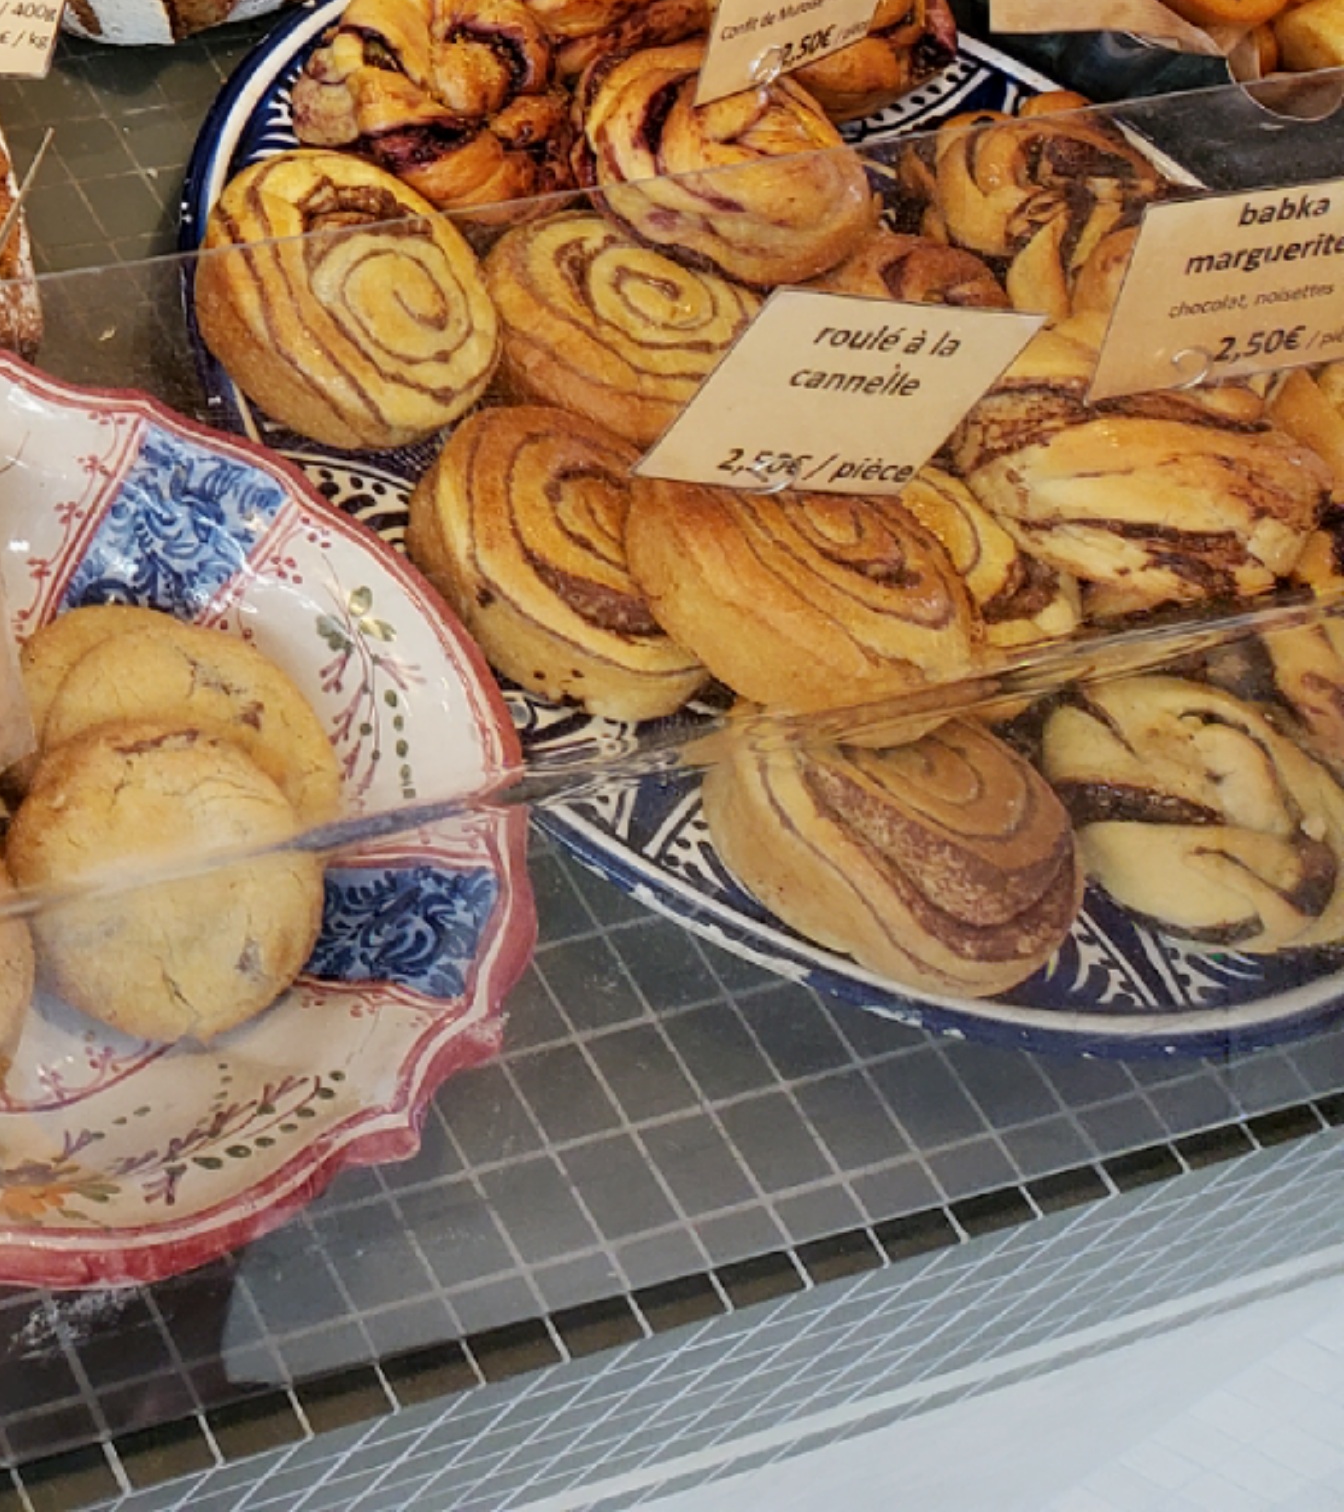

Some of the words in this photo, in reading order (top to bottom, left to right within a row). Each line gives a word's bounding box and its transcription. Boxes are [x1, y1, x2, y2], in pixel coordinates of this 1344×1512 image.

[11, 2, 56, 22] 400g
[1238, 194, 1330, 227] babka
[813, 324, 902, 353] roulé
[902, 330, 927, 356] à
[930, 331, 961, 358] la
[1213, 325, 1306, 364] 2,50€
[790, 364, 921, 397] cannelle
[829, 456, 913, 485] pièce
